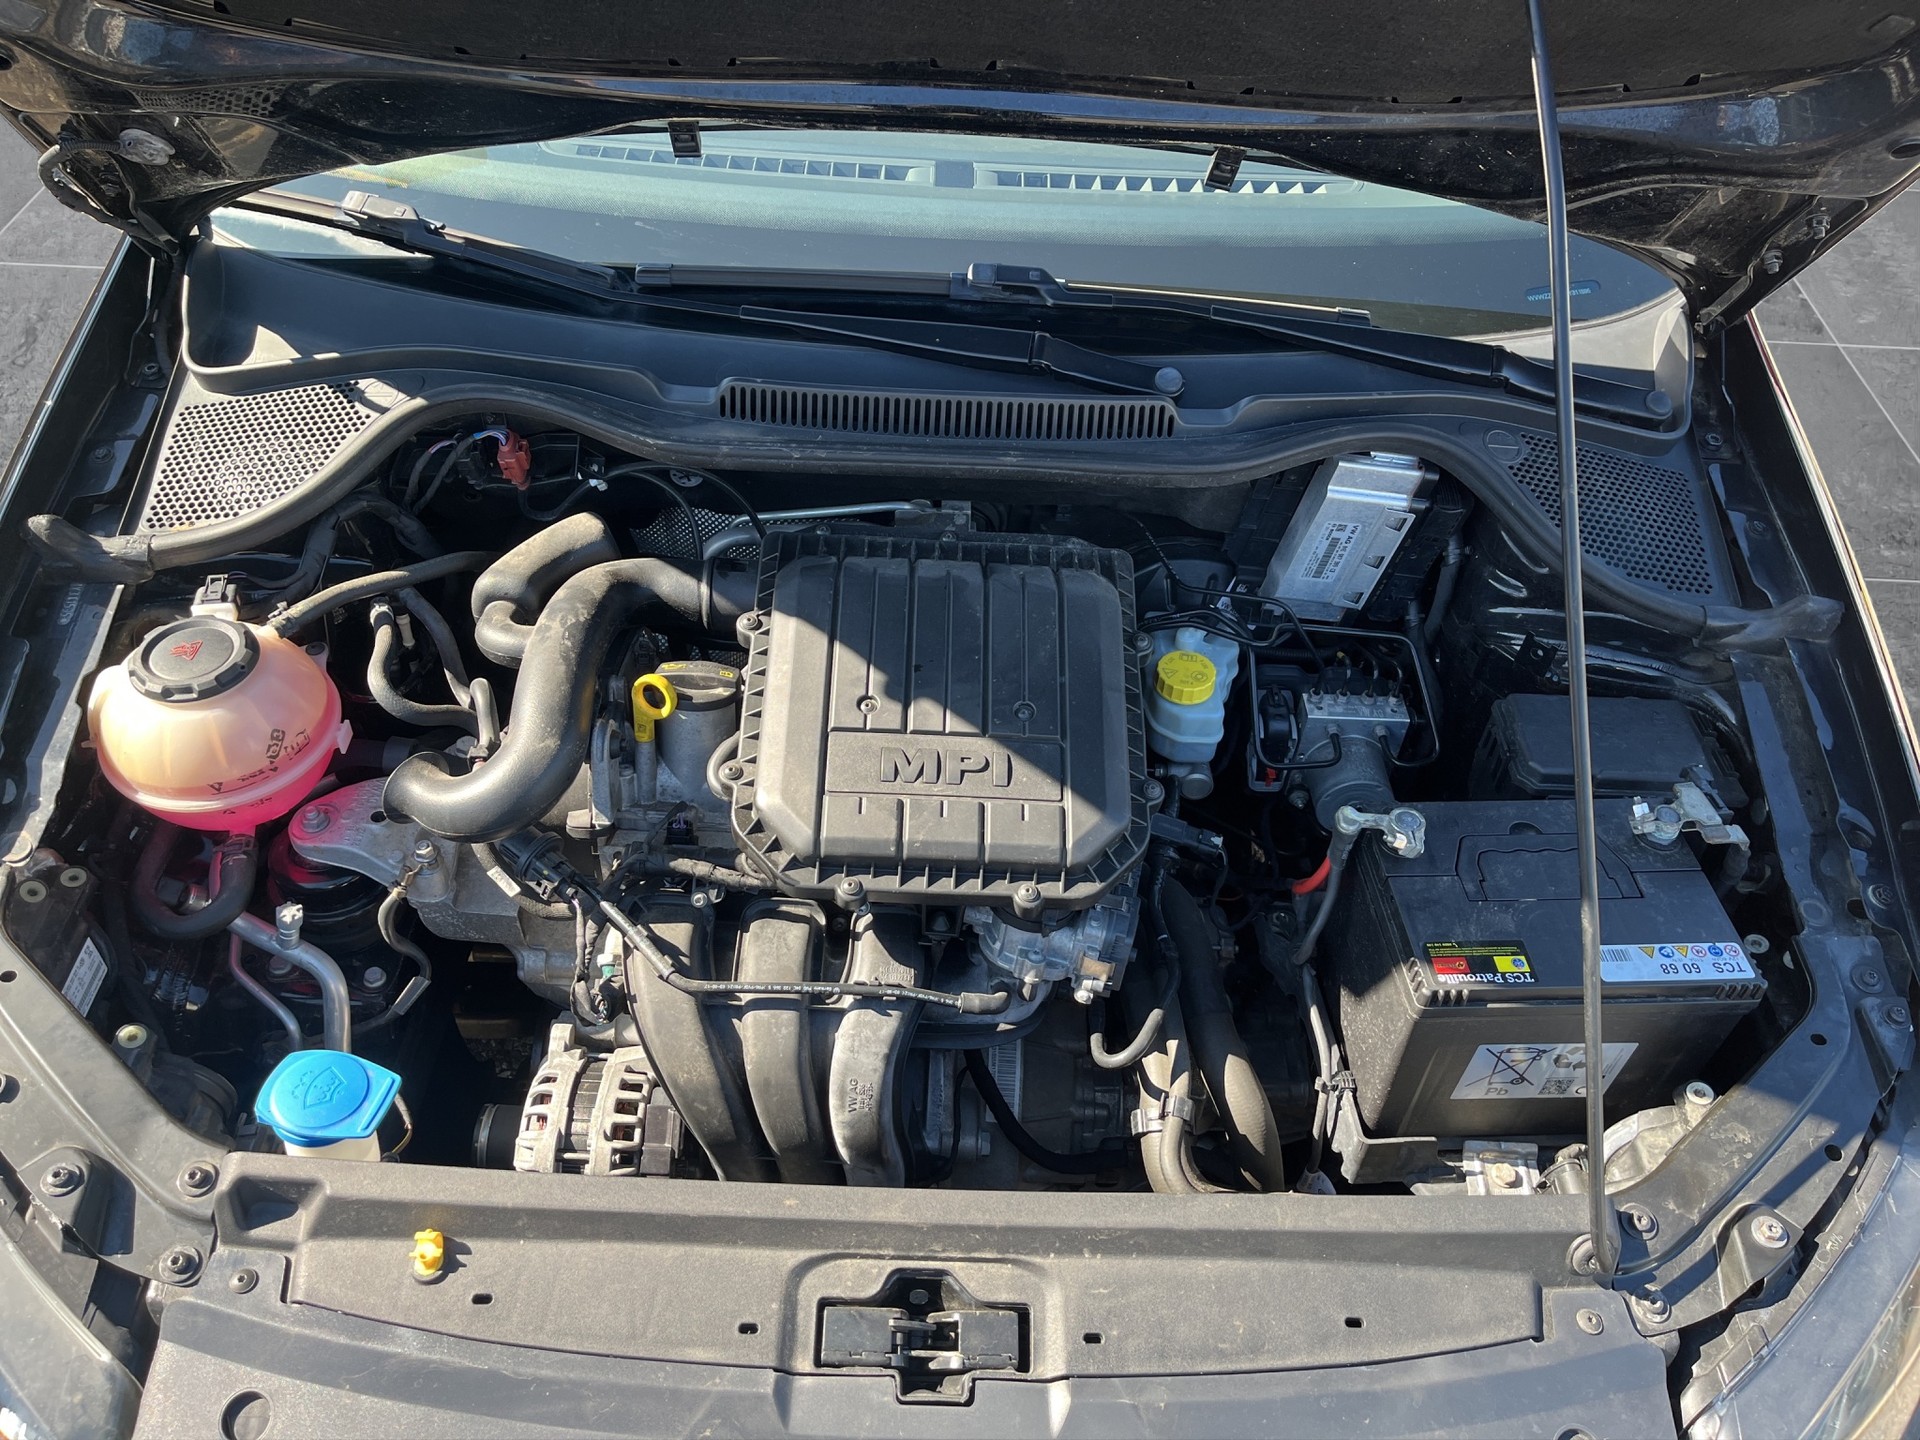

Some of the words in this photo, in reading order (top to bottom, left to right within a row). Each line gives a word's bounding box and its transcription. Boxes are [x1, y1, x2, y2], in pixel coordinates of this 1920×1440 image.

[881, 747, 1012, 788] MPI
[1660, 963, 1679, 974] 68
[1682, 962, 1701, 974] 60
[1712, 961, 1746, 973] TCS
[1437, 973, 1504, 984] Patrouille
[1505, 973, 1535, 983] TCS
[849, 1078, 858, 1095] AG
[1485, 1087, 1509, 1096] Pb
[848, 1095, 857, 1113] VW
